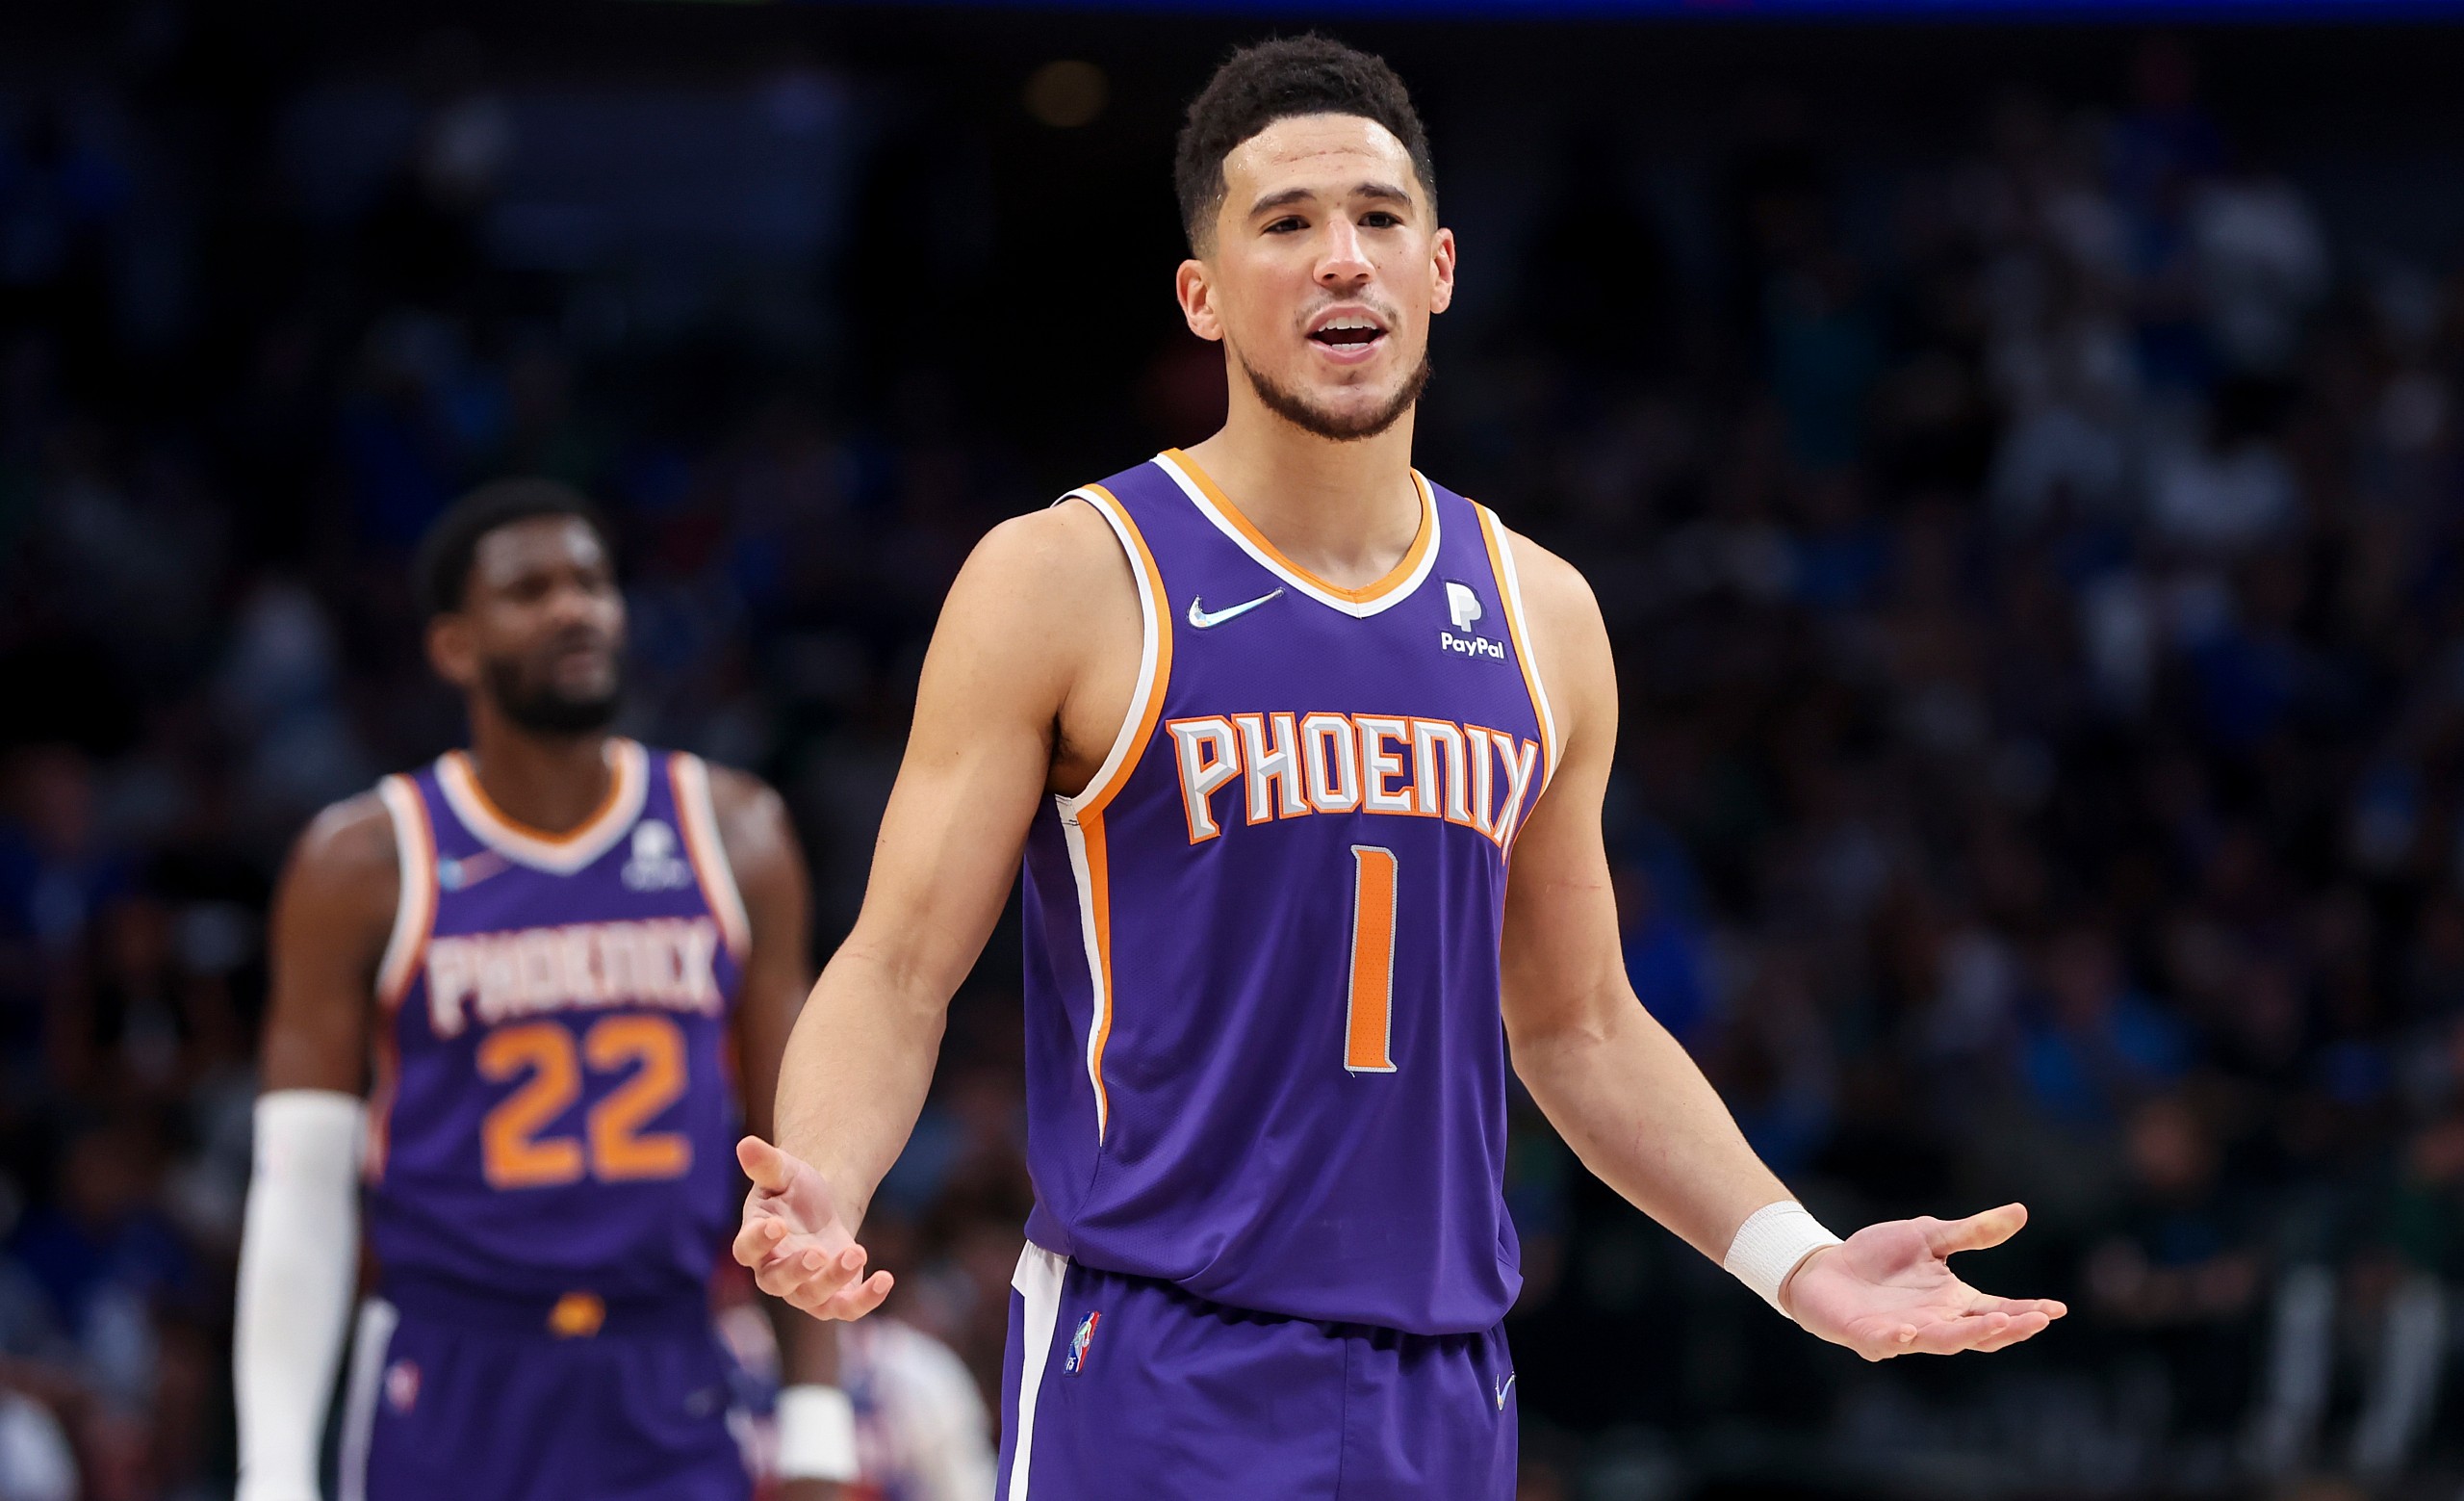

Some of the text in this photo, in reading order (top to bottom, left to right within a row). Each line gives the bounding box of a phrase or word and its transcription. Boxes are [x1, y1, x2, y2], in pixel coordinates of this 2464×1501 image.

[1441, 632, 1504, 660] PayPal
[1166, 712, 1539, 866] PHOENIX
[1344, 844, 1399, 1073] 1
[478, 1015, 690, 1188] 22
